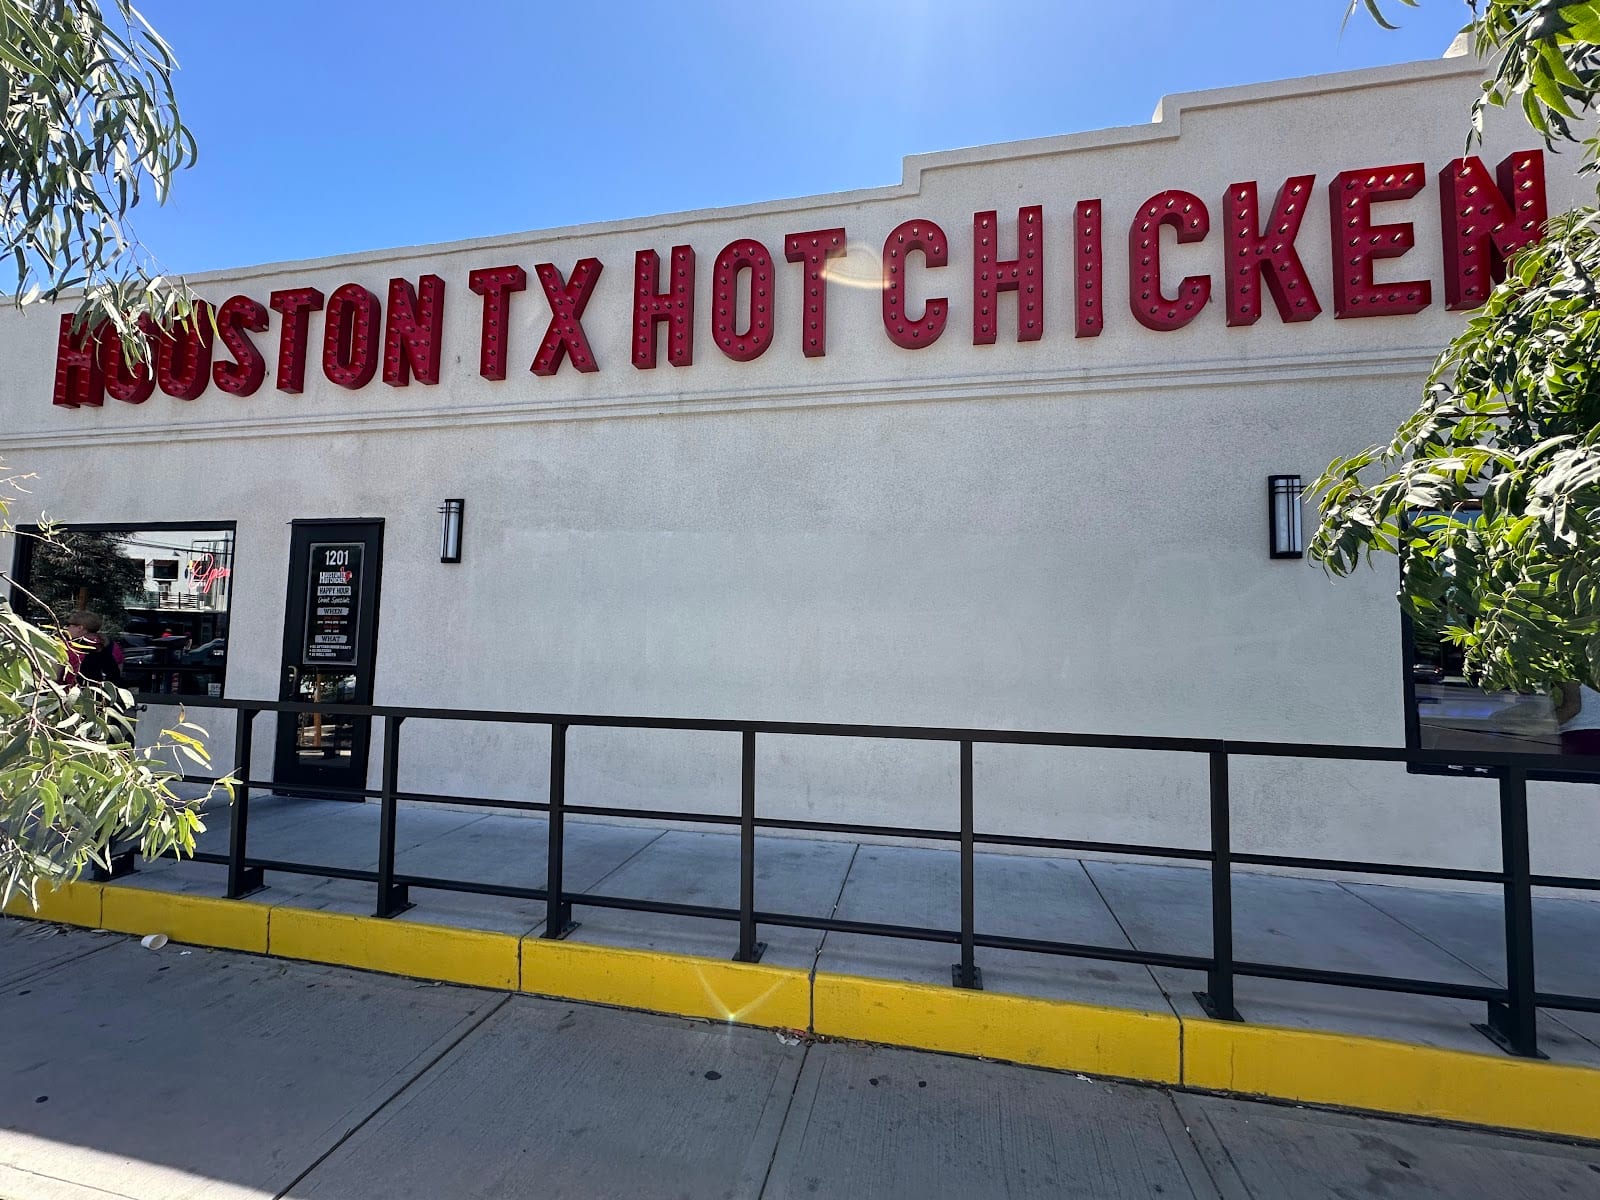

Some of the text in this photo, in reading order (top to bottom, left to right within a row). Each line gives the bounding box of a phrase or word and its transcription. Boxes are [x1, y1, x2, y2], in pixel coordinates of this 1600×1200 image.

[53, 149, 1549, 409] HOUSTON TX HOT CHICKEN
[189, 552, 231, 593] Open
[325, 550, 349, 565] 1201
